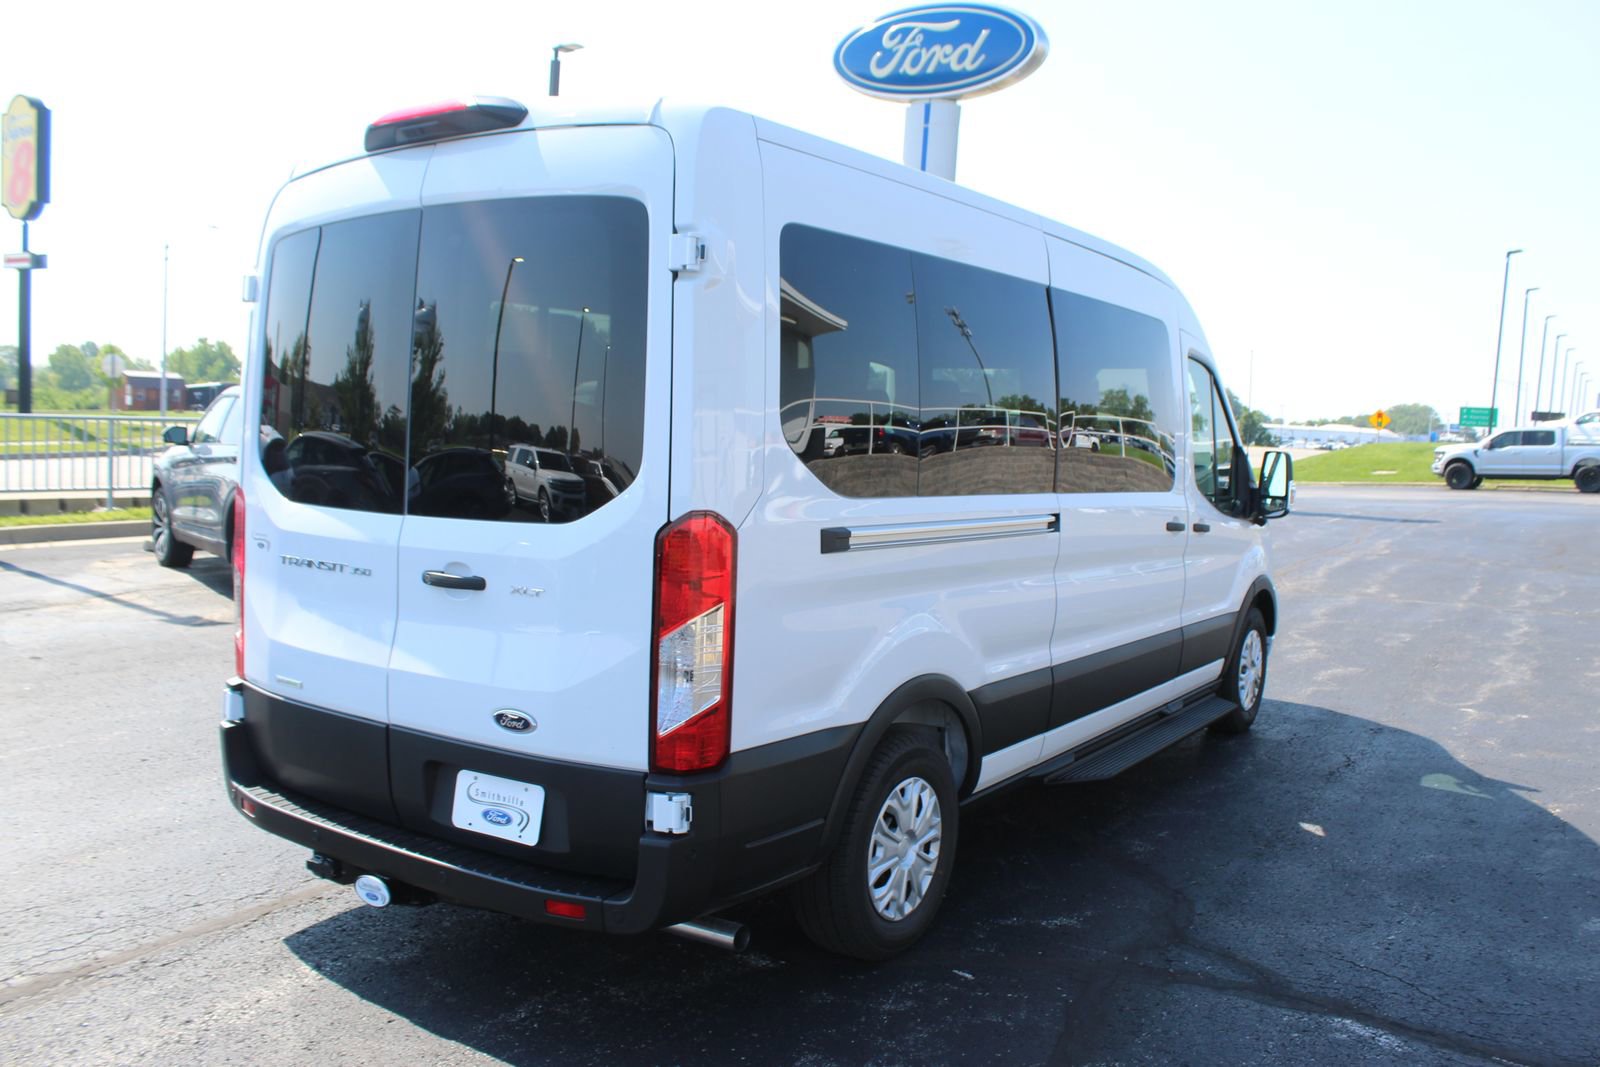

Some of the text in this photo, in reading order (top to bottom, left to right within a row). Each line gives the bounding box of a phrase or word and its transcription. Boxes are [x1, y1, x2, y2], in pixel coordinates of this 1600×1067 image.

[869, 19, 991, 79] Ford
[9, 138, 35, 206] 8
[280, 554, 349, 574] TRANSIT
[499, 713, 525, 729] Ford
[474, 788, 524, 807] Smithville
[486, 809, 508, 825] Ford
